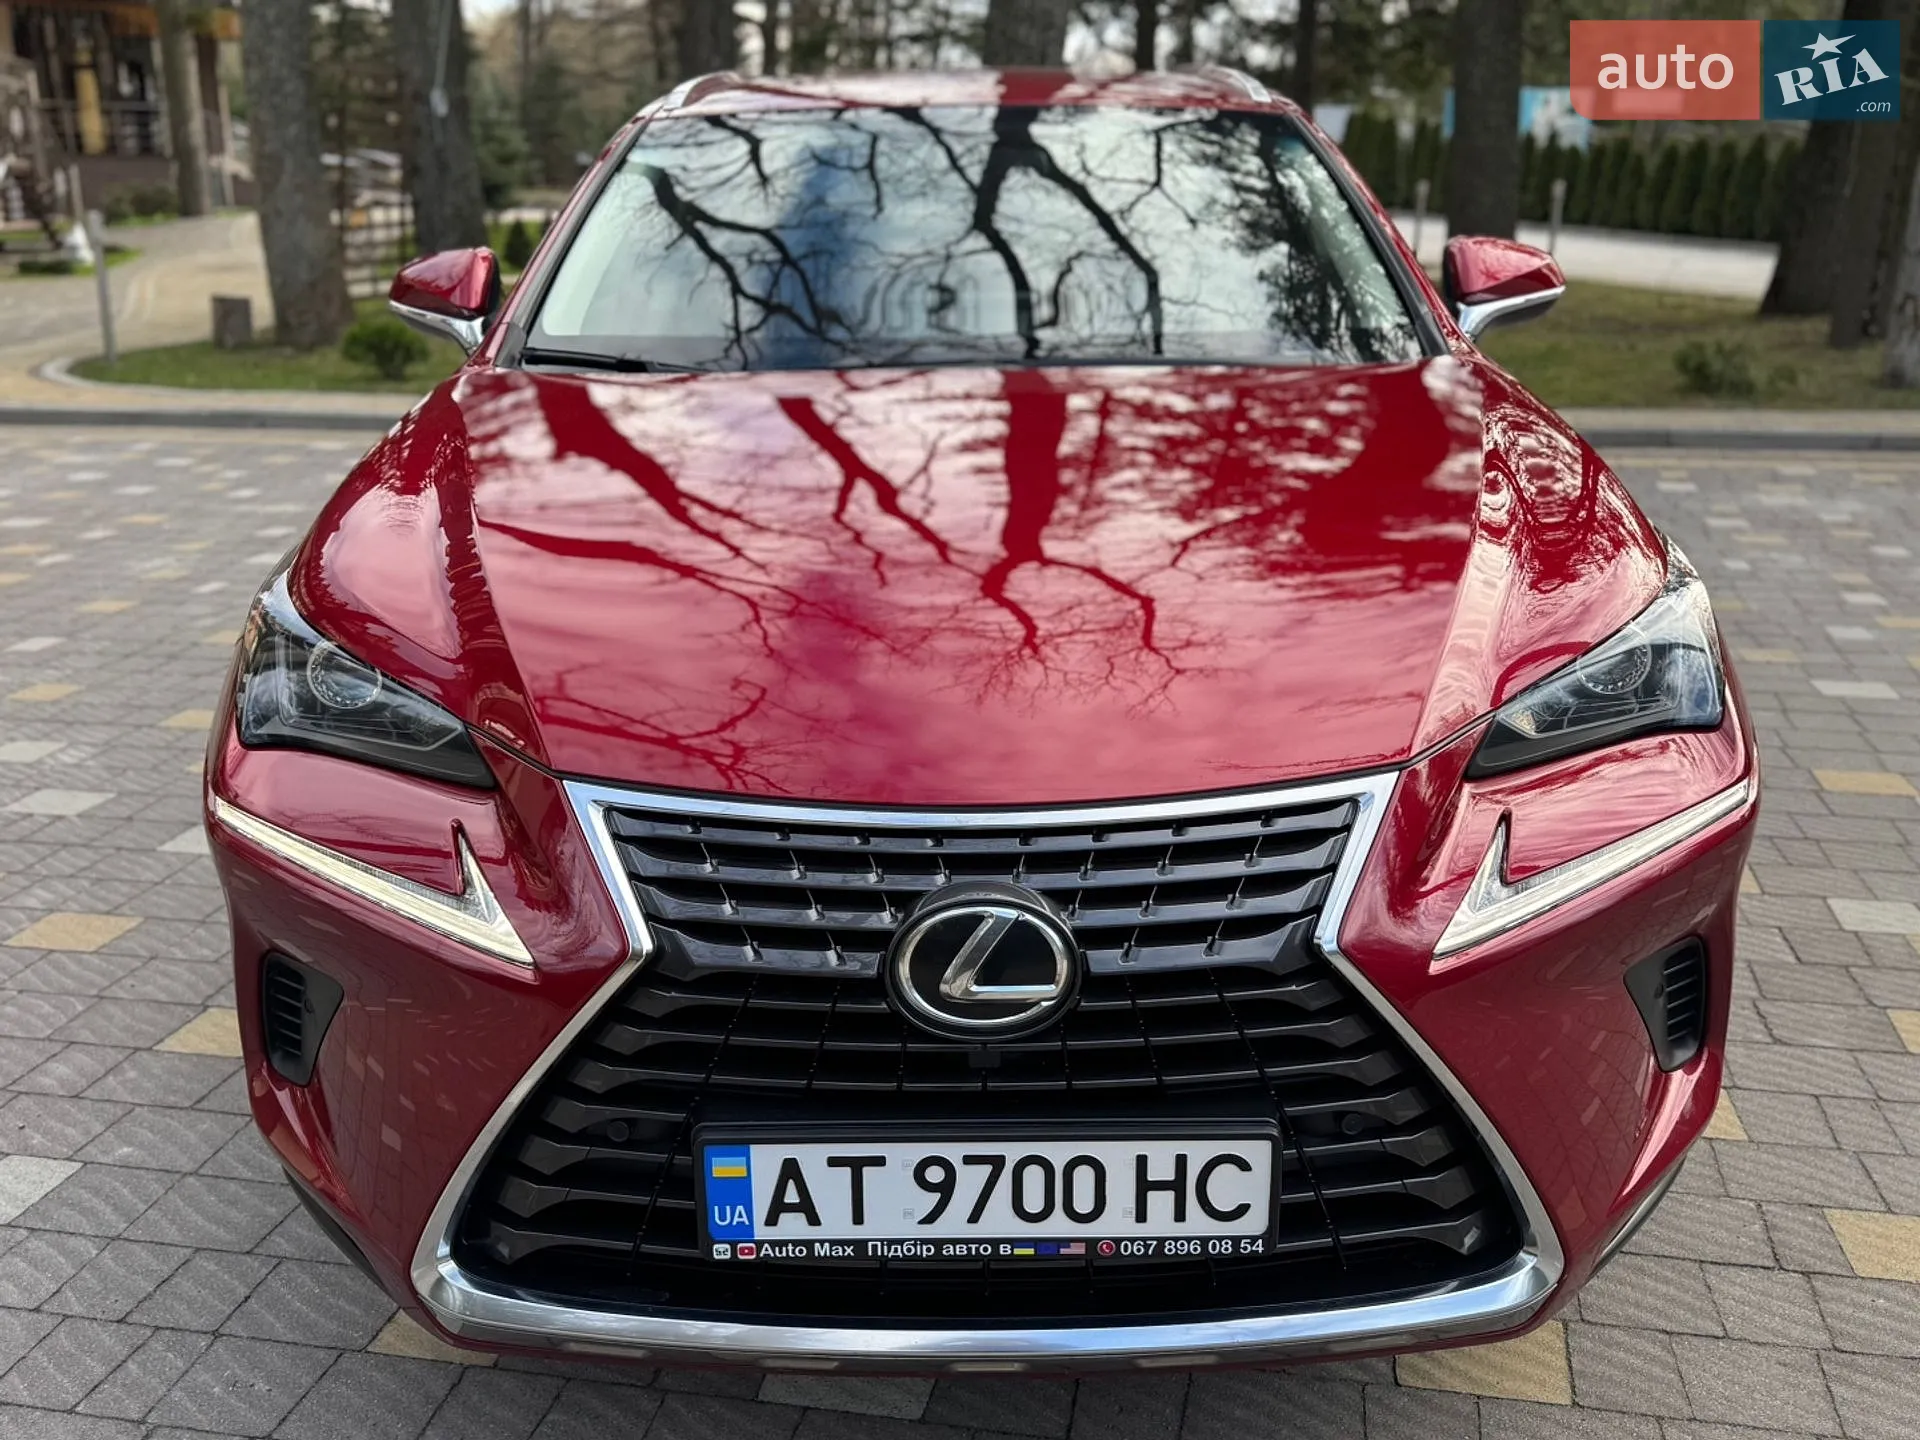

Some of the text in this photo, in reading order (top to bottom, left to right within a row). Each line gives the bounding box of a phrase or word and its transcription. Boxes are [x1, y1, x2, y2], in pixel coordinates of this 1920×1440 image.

[763, 1153, 1253, 1227] AT 9700 HC
[713, 1205, 750, 1227] UA
[759, 1242, 807, 1258] Auto
[813, 1242, 855, 1257] Max
[867, 1240, 935, 1258] Підбір
[942, 1243, 992, 1256] авто
[1120, 1240, 1157, 1255] 067
[1164, 1240, 1201, 1255] 896
[1207, 1239, 1233, 1254] 08
[1239, 1239, 1265, 1254] 54
